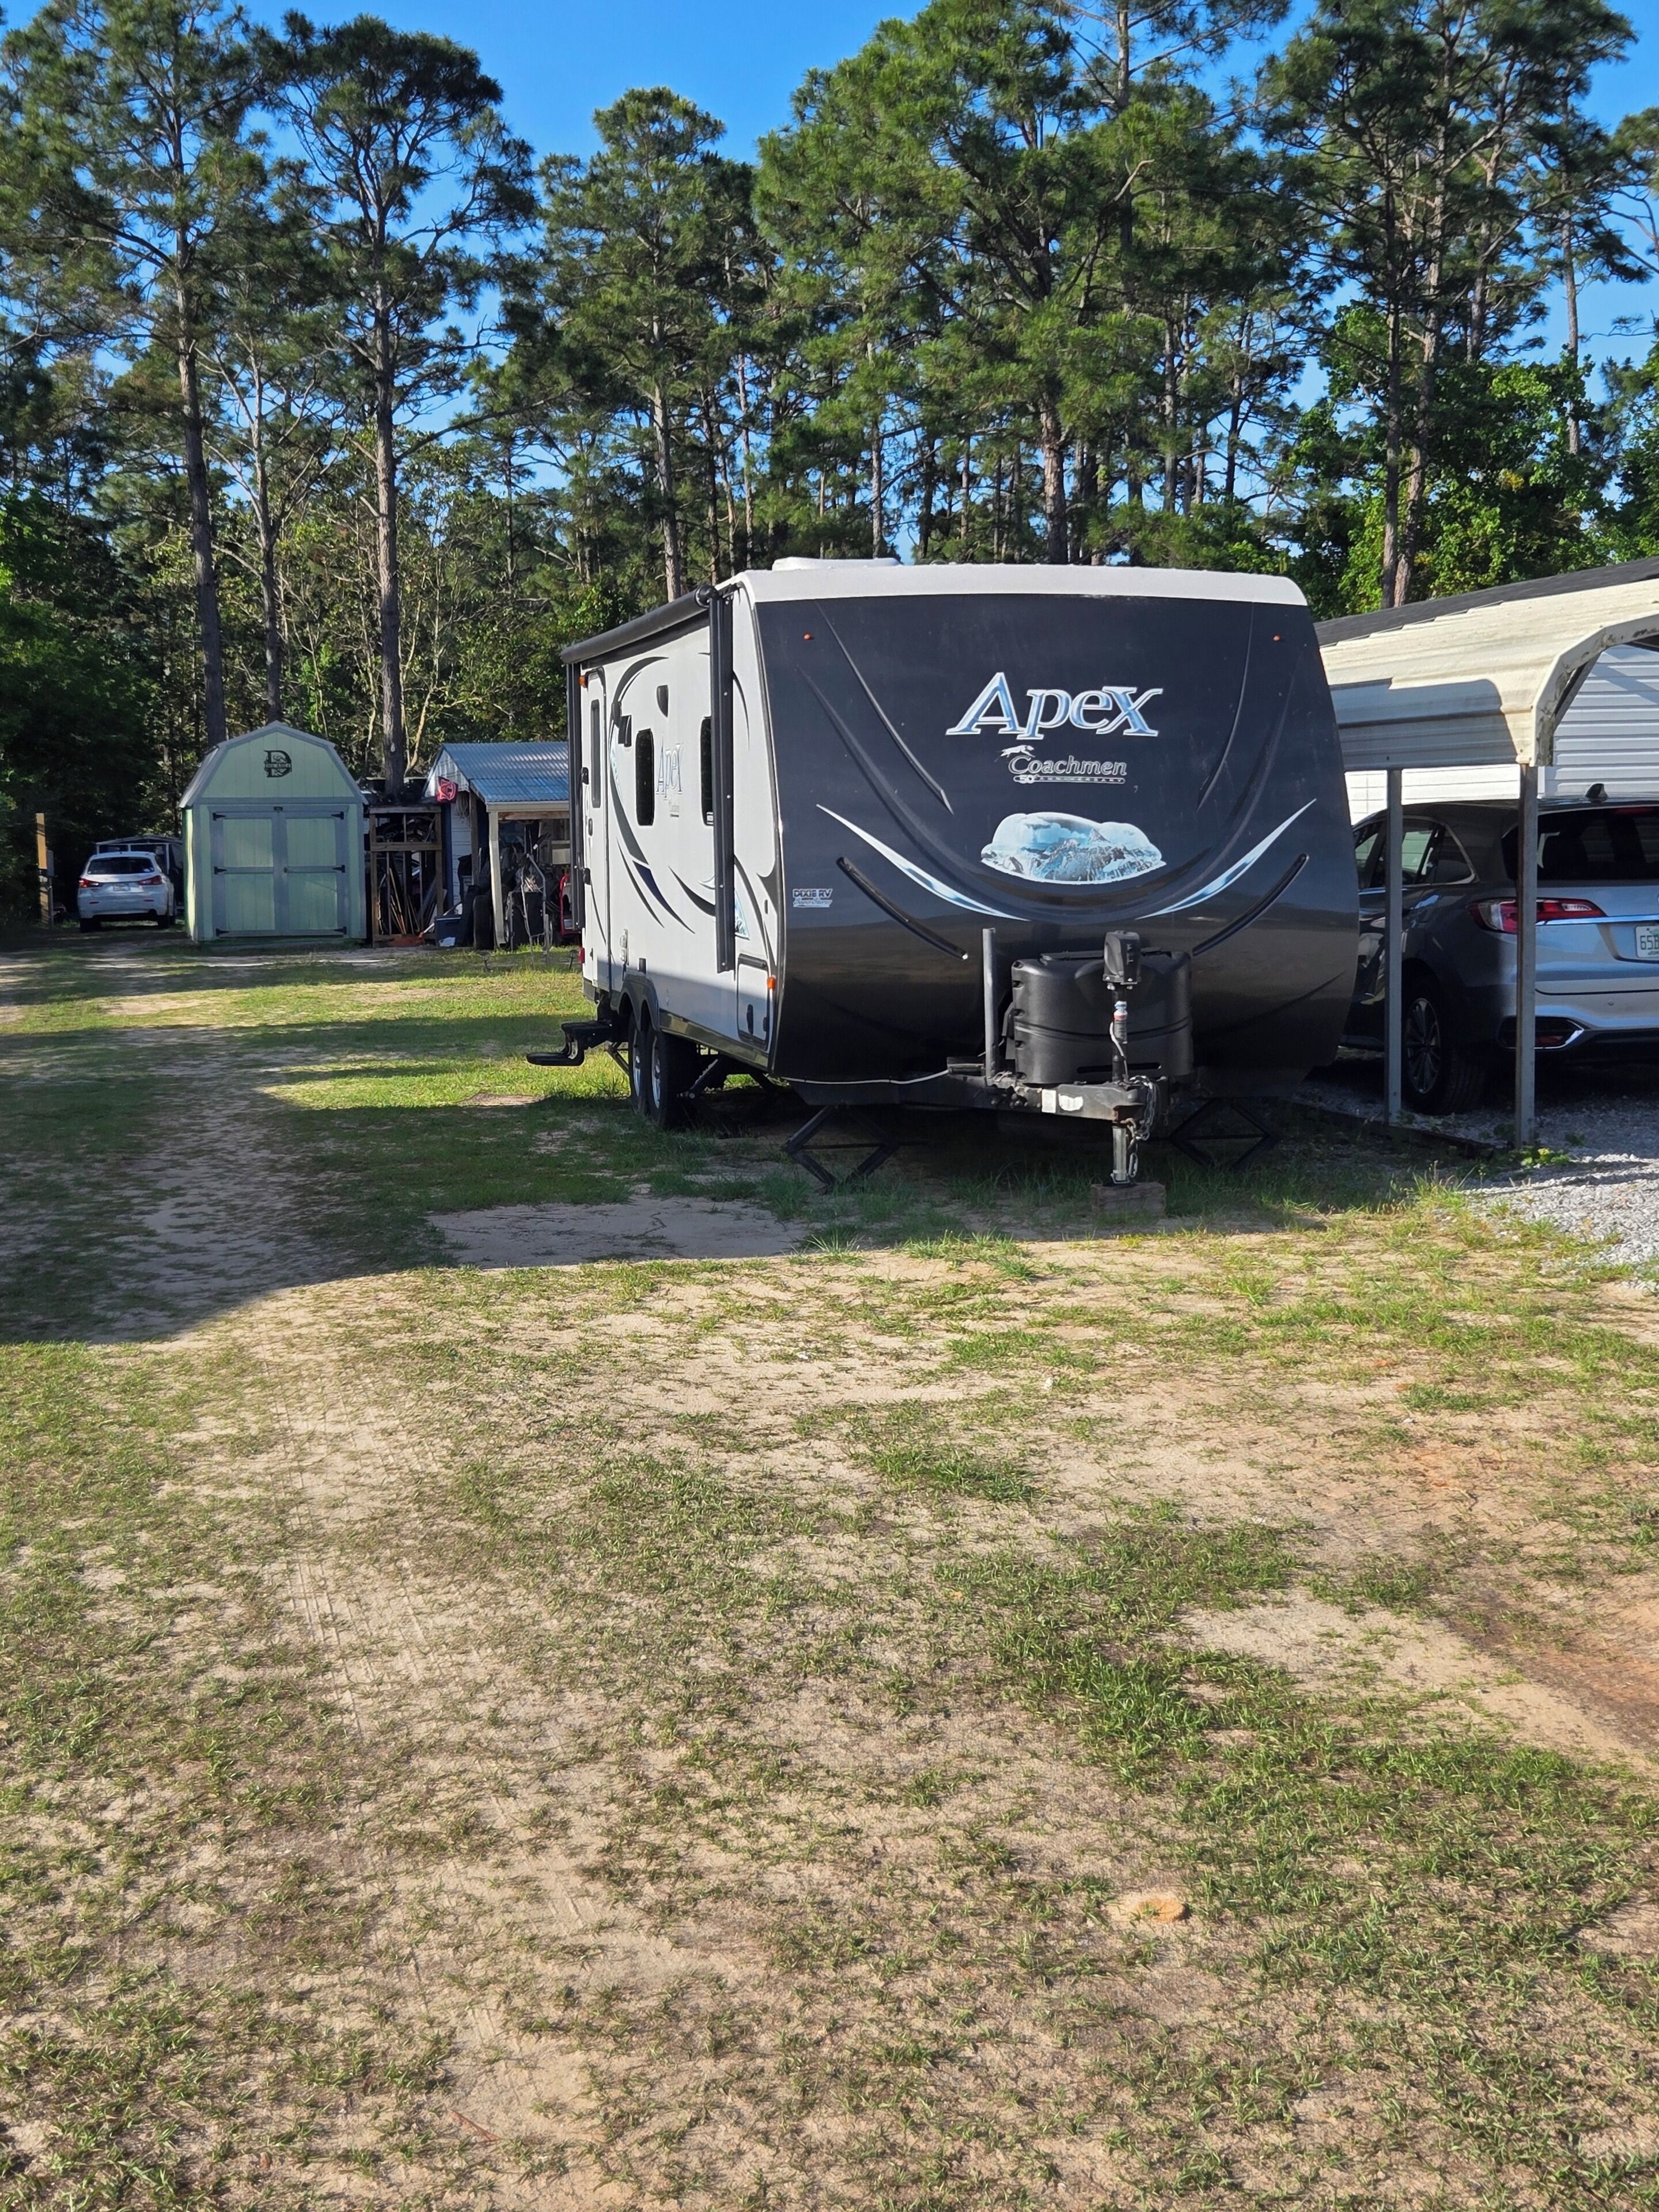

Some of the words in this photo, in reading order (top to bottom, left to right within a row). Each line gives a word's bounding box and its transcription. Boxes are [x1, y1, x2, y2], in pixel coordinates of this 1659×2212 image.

[945, 672, 1164, 740] Apex
[656, 733, 684, 801] Apex
[1008, 755, 1127, 776] Coachmen
[818, 889, 832, 897] RV
